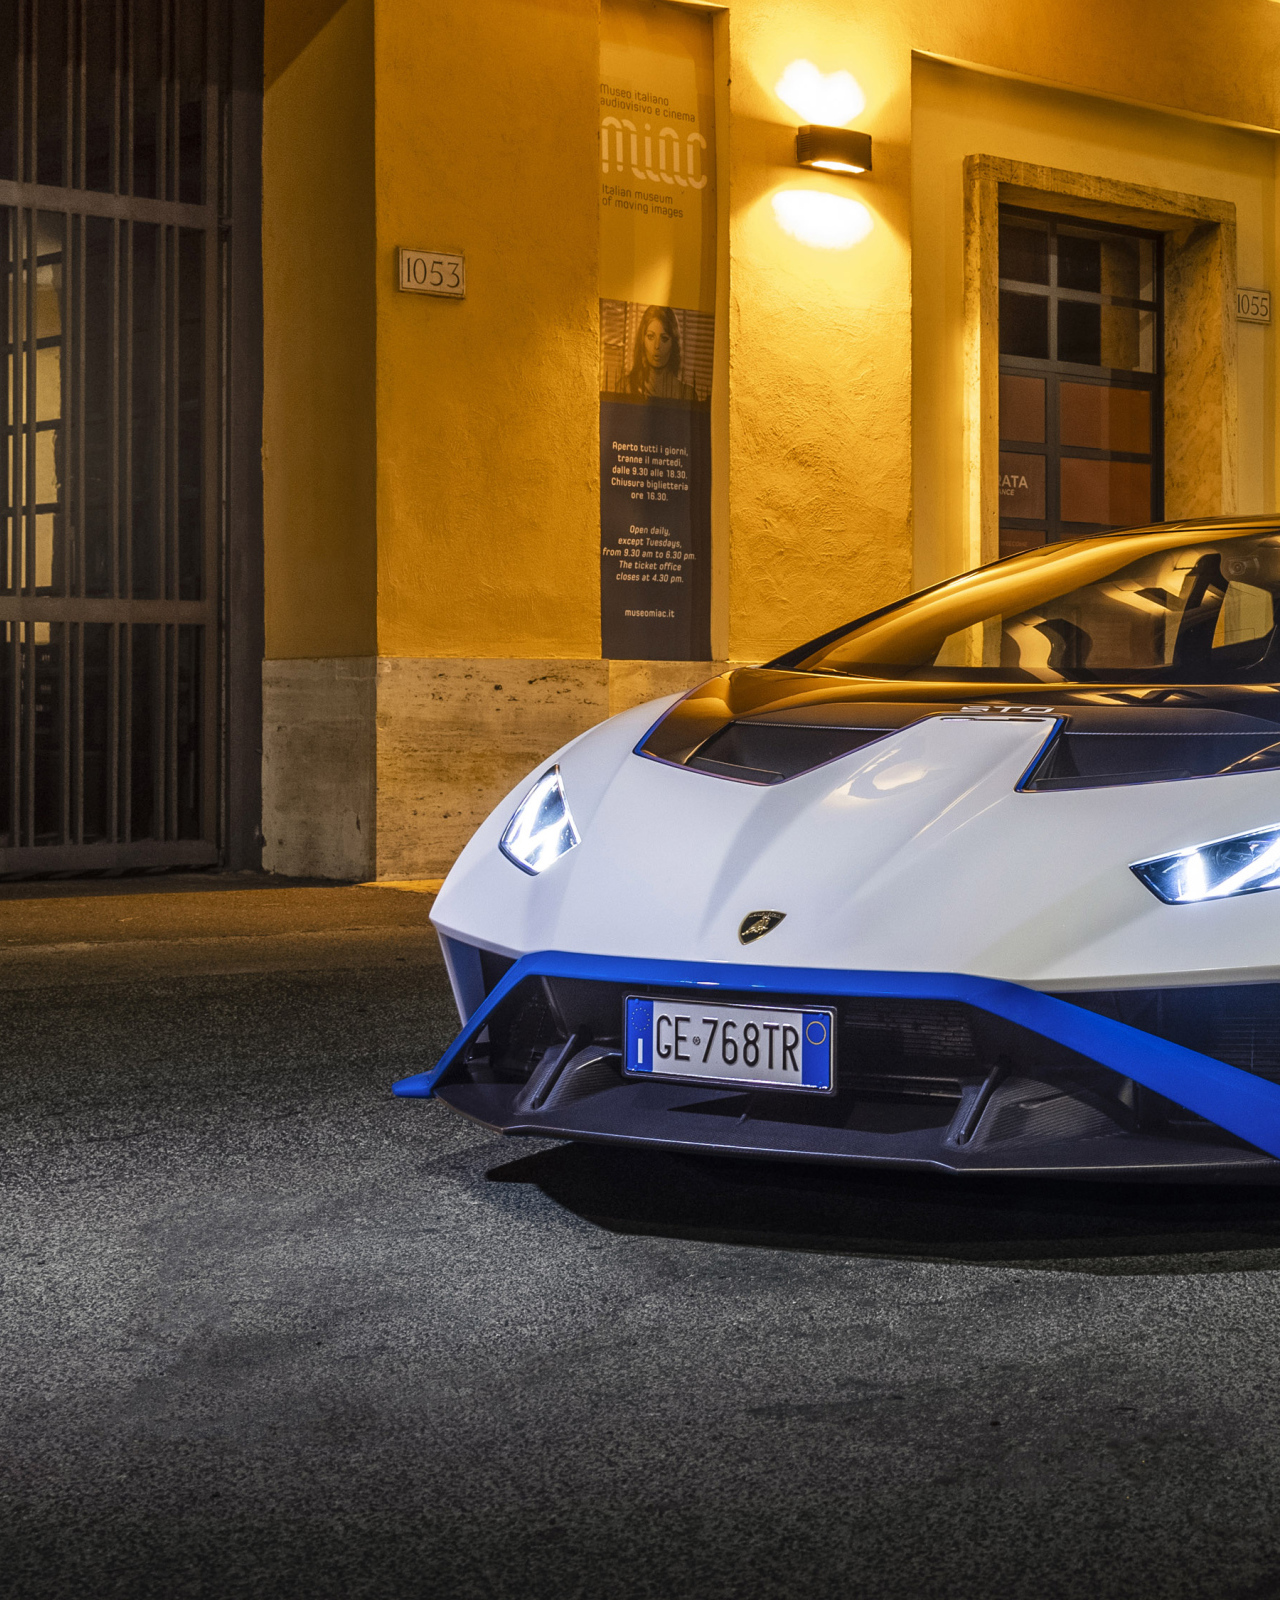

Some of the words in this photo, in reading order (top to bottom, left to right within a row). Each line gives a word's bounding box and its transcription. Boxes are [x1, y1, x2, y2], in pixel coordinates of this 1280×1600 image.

[600, 83, 631, 99] Museo
[634, 89, 669, 106] italiano
[600, 97, 652, 115] audiovisivo
[655, 107, 660, 116] e
[663, 107, 696, 123] cinema
[602, 183, 632, 198] Italian
[634, 190, 673, 205] museum
[602, 196, 613, 206] of
[614, 199, 649, 215] moving
[651, 204, 684, 219] images
[407, 257, 460, 288] 1053
[1237, 294, 1269, 317] 1055
[612, 441, 638, 451] Aperto
[640, 444, 659, 453] tutti
[664, 446, 688, 456] giorni,
[617, 454, 643, 464] tranne
[644, 456, 650, 464] il
[612, 465, 630, 475] dalle
[632, 467, 648, 476] 9.30
[650, 469, 664, 477] alle
[611, 477, 645, 488] Chiusura
[646, 480, 689, 491] biglietteria
[629, 524, 648, 535] Open
[650, 526, 671, 537] daily,
[618, 537, 644, 547] except
[645, 538, 682, 549] Tuesdays,
[602, 547, 622, 556] from
[623, 548, 640, 557] 9.30
[655, 551, 664, 559] to
[665, 550, 682, 559] 6.30
[683, 553, 697, 561] pm.
[619, 560, 633, 569] The
[634, 561, 657, 570] ticket
[659, 562, 682, 571] office
[615, 572, 640, 581] closes
[641, 574, 650, 582] at
[651, 573, 669, 583] 4.30
[670, 575, 684, 584] pm.
[624, 609, 675, 618] museomiac.it
[960, 705, 1055, 713] STO
